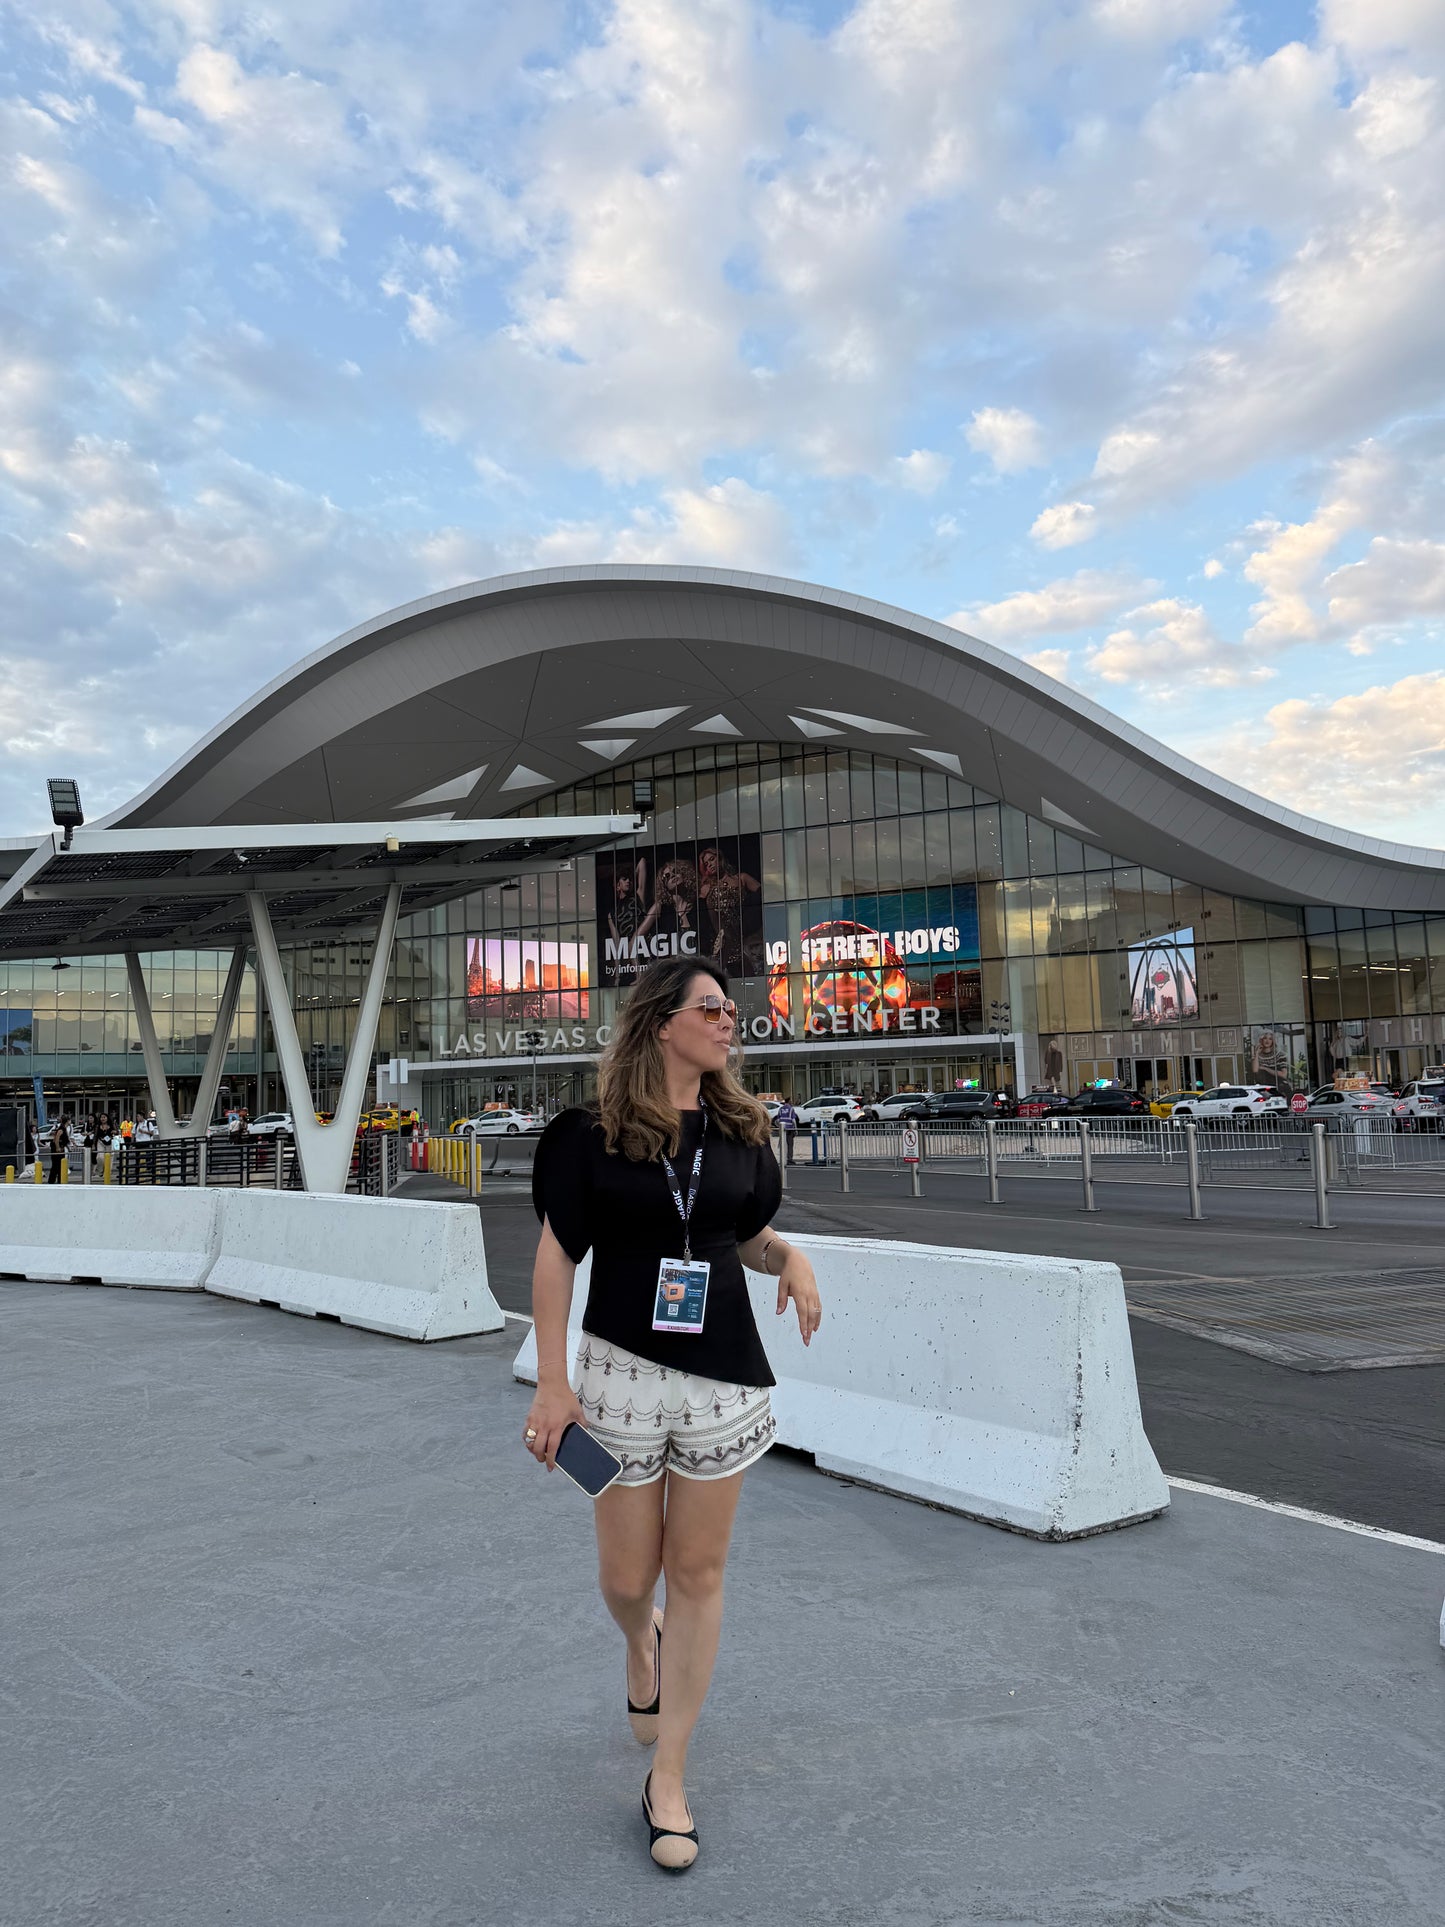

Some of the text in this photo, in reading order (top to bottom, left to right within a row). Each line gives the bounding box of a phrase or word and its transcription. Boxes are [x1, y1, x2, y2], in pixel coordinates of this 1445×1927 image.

[605, 931, 697, 961] MAGIC
[895, 926, 960, 955] BOYS
[605, 964, 648, 977] by inform
[439, 1033, 487, 1055] LAS
[495, 1026, 587, 1052] VEGAS
[809, 1006, 941, 1035] CENTER
[1292, 1100, 1307, 1109] STOP
[692, 1148, 703, 1176] MAGIC
[672, 1189, 686, 1220] MAGIC
